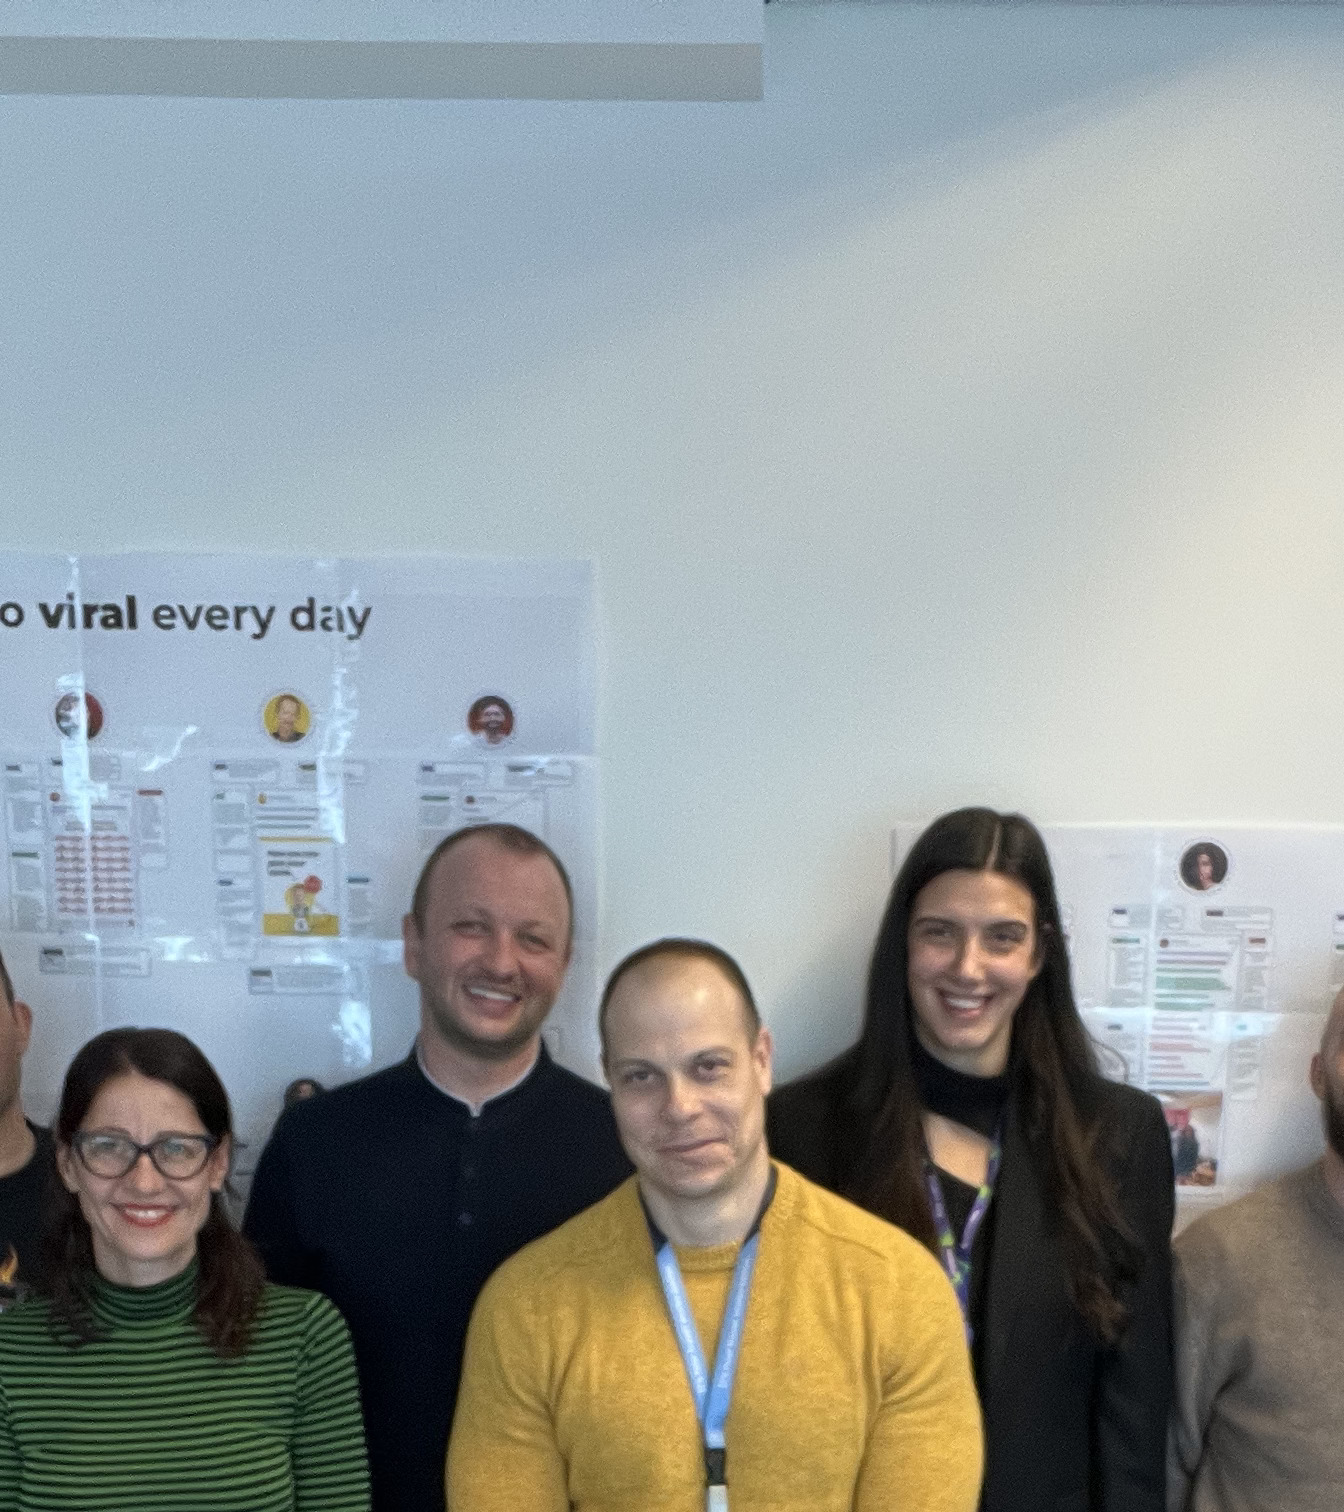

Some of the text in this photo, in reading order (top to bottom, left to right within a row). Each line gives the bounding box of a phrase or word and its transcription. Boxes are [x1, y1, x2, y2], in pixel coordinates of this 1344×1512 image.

[38, 592, 138, 630] viral
[151, 603, 276, 640] every
[289, 597, 372, 641] day
